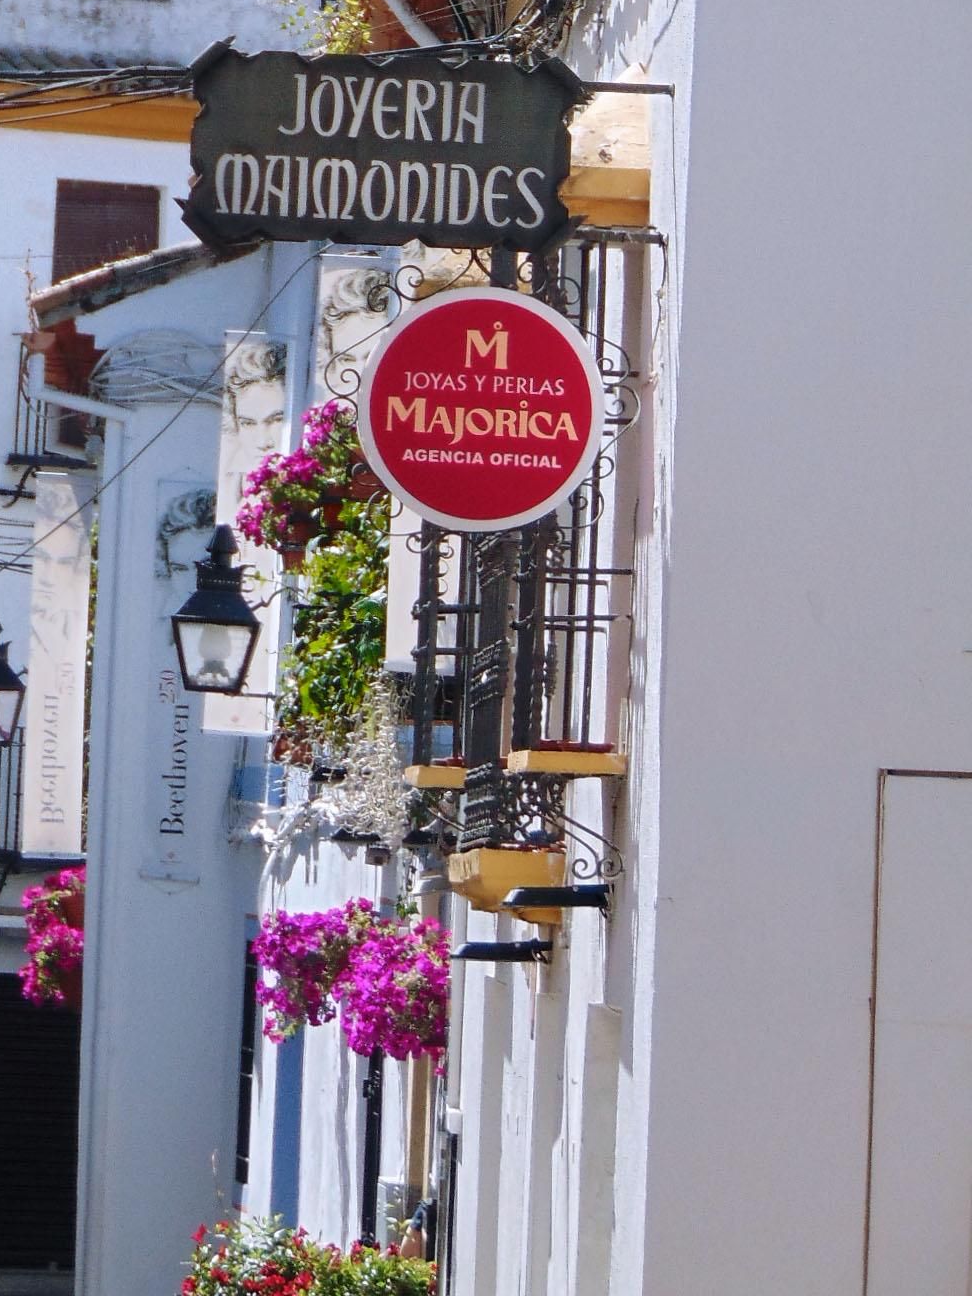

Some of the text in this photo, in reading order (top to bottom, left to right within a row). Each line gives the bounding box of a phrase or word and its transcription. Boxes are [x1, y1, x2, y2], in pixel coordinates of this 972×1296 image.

[277, 73, 486, 144] JOYERIA
[214, 152, 546, 229] MAIMONIDES
[404, 370, 565, 396] JOYAS Y PERLAS
[402, 448, 562, 469] AGENCIA OFICIAL
[159, 704, 189, 835] Beethoven
